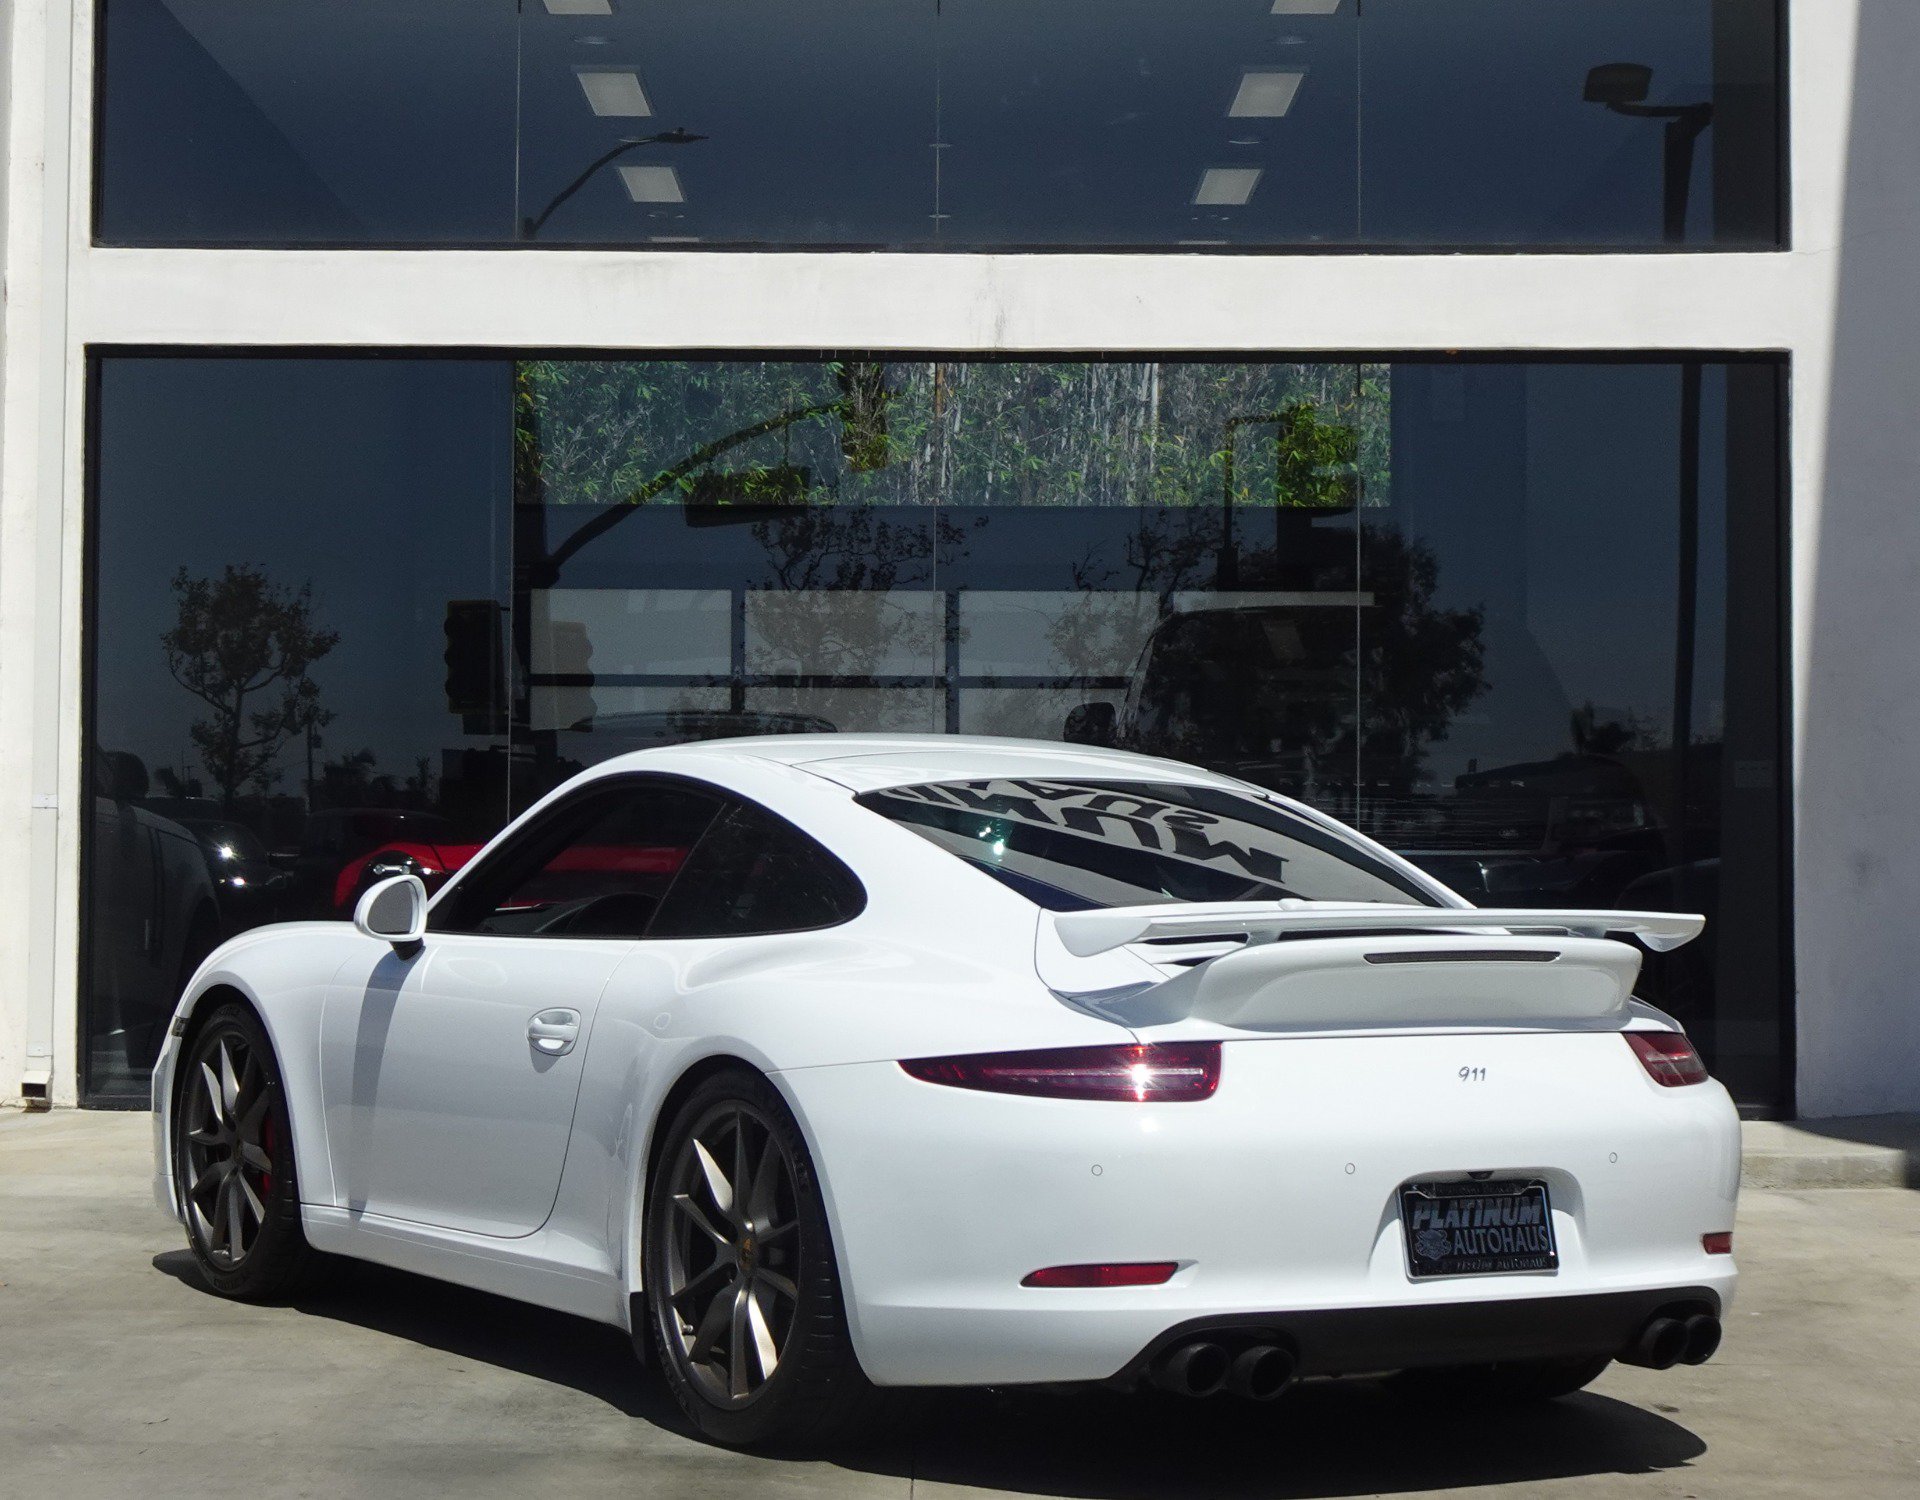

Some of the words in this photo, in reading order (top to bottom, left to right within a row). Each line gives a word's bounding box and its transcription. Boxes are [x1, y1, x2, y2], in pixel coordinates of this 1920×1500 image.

[1458, 1065, 1486, 1082] 911
[1412, 1195, 1543, 1230] PLATINUM
[1453, 1225, 1549, 1256] AUTOHAUS
